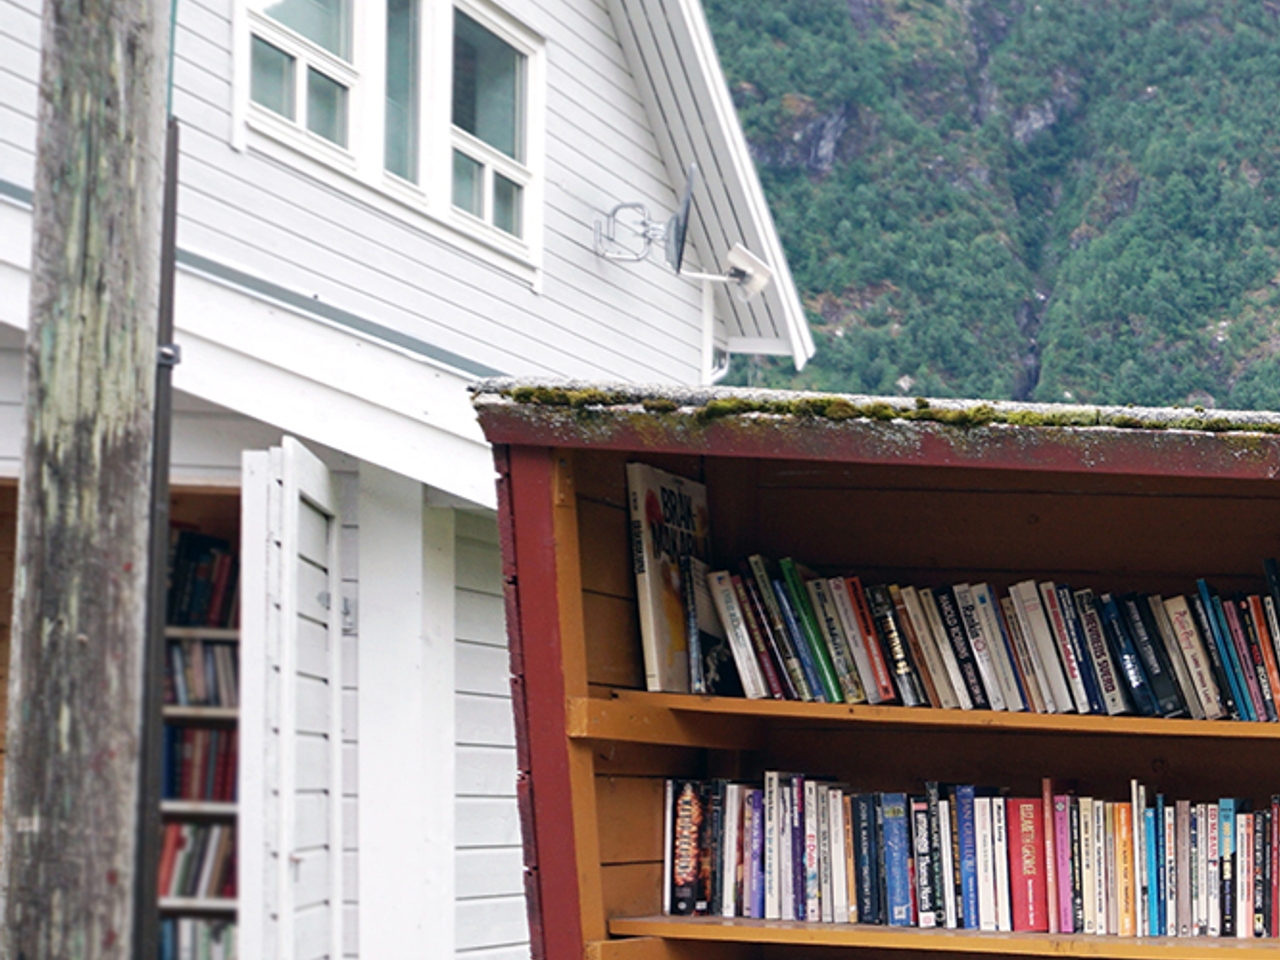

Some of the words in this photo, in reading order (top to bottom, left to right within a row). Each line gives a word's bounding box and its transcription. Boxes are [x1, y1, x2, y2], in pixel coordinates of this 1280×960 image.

[960, 797, 974, 819] JAN
[1019, 804, 1034, 843] ELIZABETH
[1209, 807, 1218, 820] ED
[962, 820, 976, 873] GUILLOU
[1021, 843, 1036, 876] GEORGE
